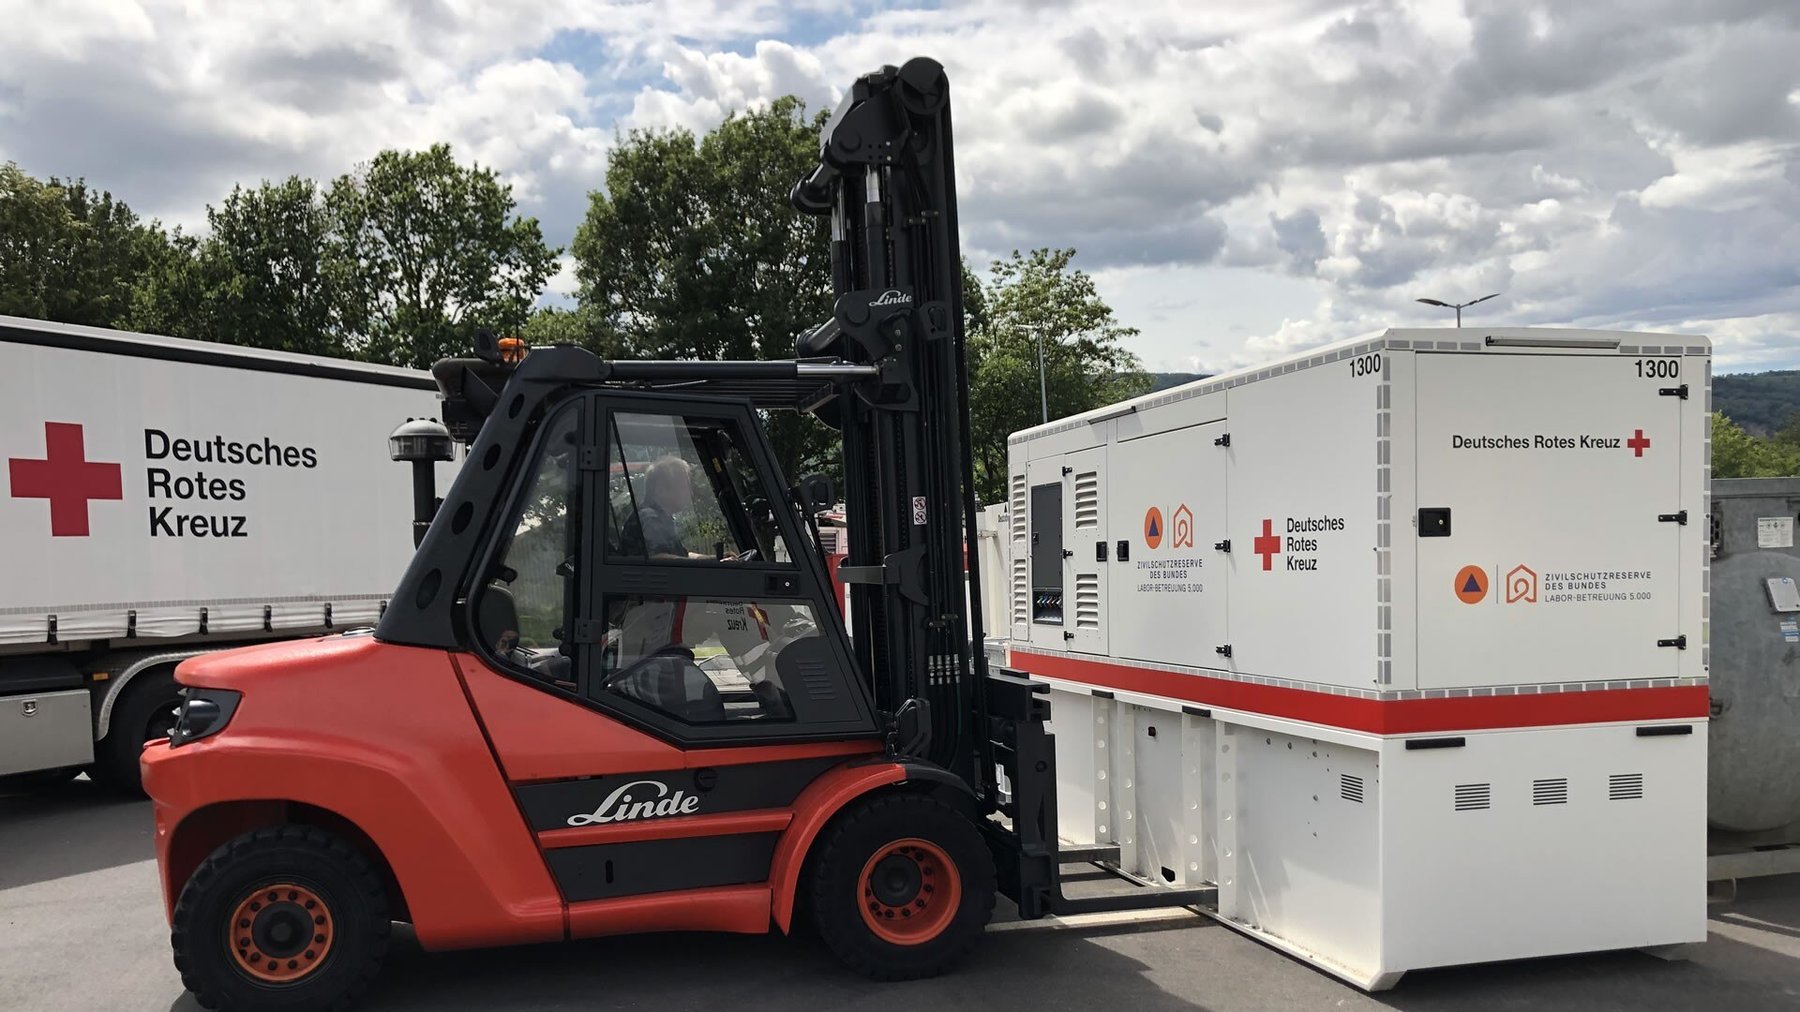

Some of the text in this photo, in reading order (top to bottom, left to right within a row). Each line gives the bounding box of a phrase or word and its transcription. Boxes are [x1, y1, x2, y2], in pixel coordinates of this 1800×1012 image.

[869, 290, 912, 306] Linde
[1349, 353, 1381, 378] 1300
[1634, 359, 1679, 378] 1300
[145, 428, 317, 468] Deutsches
[1452, 435, 1621, 449] Deutsches Rotes Kreuz
[147, 467, 246, 501] Rotes
[149, 506, 248, 538] Kreuz
[1286, 515, 1345, 532] Deutsches
[1286, 537, 1318, 552] Rotes
[1137, 559, 1203, 569] ZIVILSCHUTZRESERVE
[1286, 556, 1318, 571] Kreuz
[1149, 570, 1188, 579] DES BUNDES
[1545, 571, 1651, 581] ZIVILSCHUTZRESERVE
[1137, 584, 1203, 593] LABOR-BETREUUNG 5.000
[1545, 581, 1607, 591] DES BUNDES
[1545, 592, 1652, 602] LABOR-BETREUUNG 5.000
[567, 781, 699, 826] Linde
